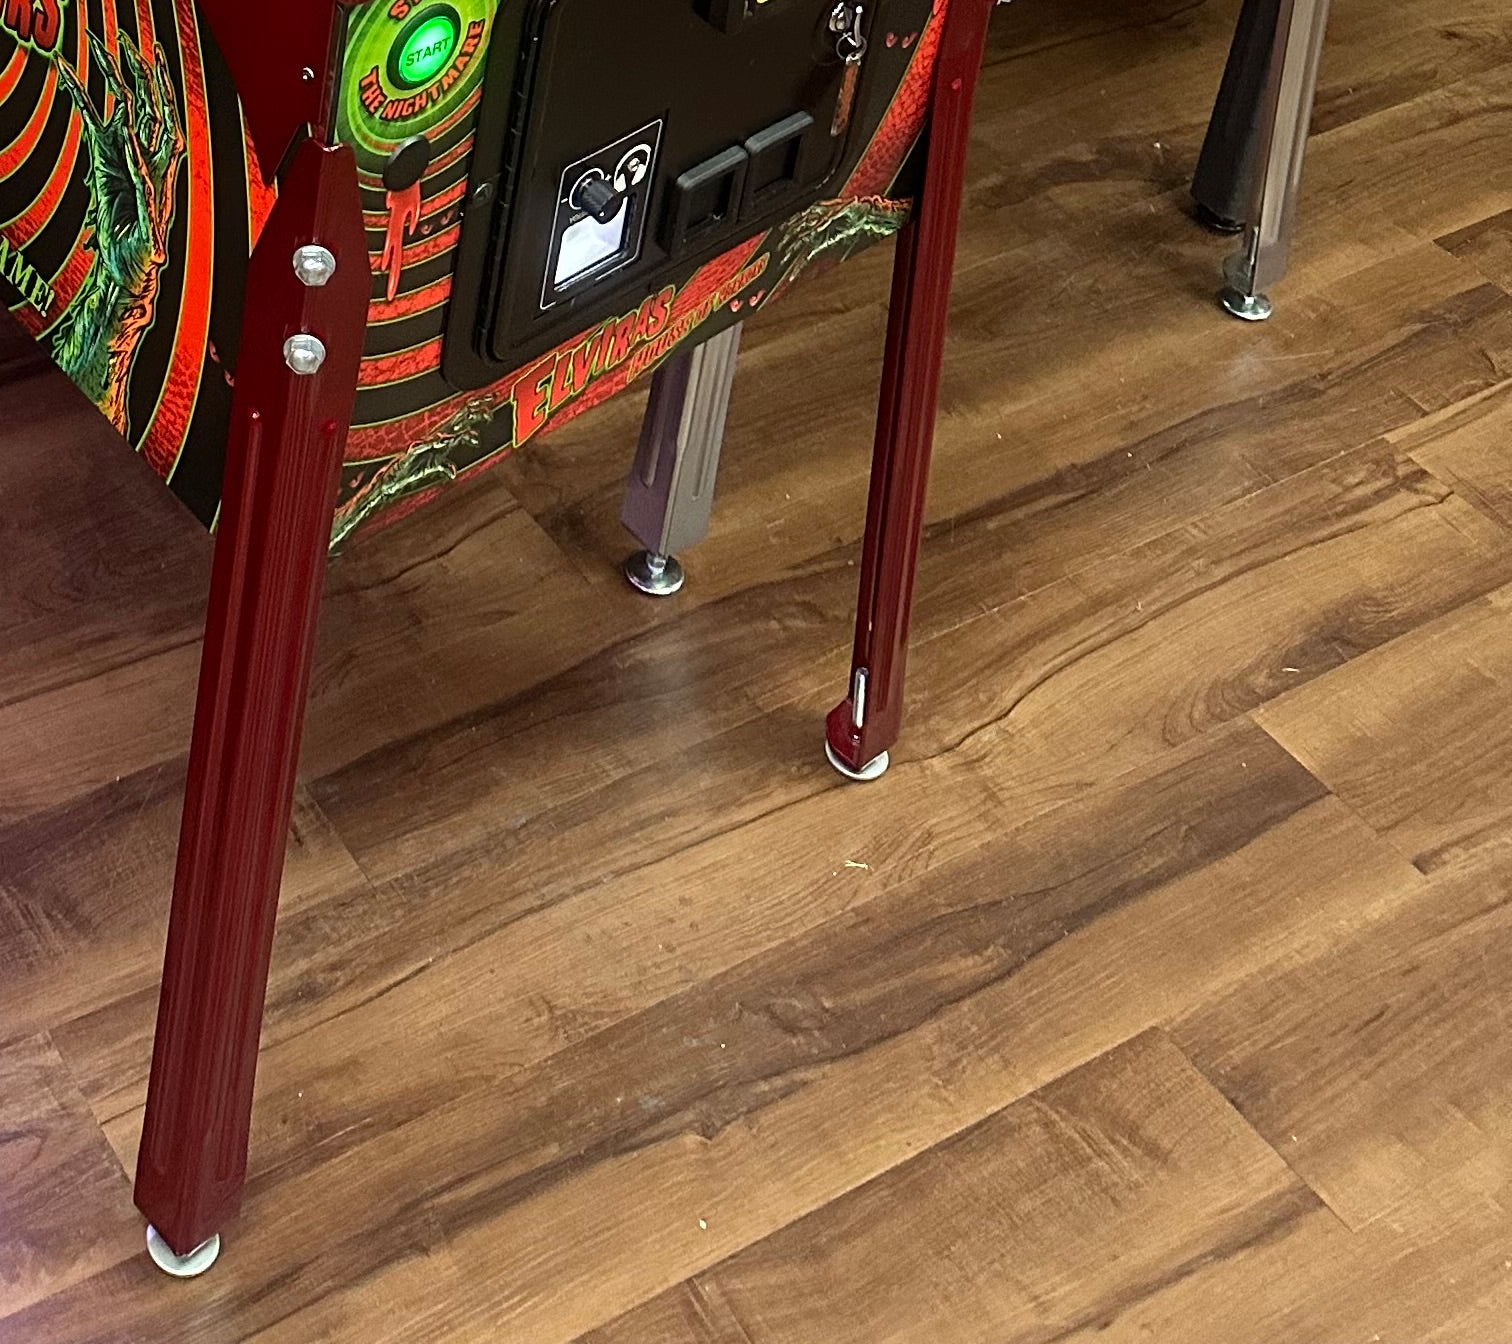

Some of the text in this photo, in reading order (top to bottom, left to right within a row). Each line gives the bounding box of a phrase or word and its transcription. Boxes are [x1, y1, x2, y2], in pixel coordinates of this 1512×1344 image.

[360, 19, 485, 121] THE NIGHTMARE
[406, 37, 451, 67] START
[512, 285, 676, 447] ELVIRA'S
